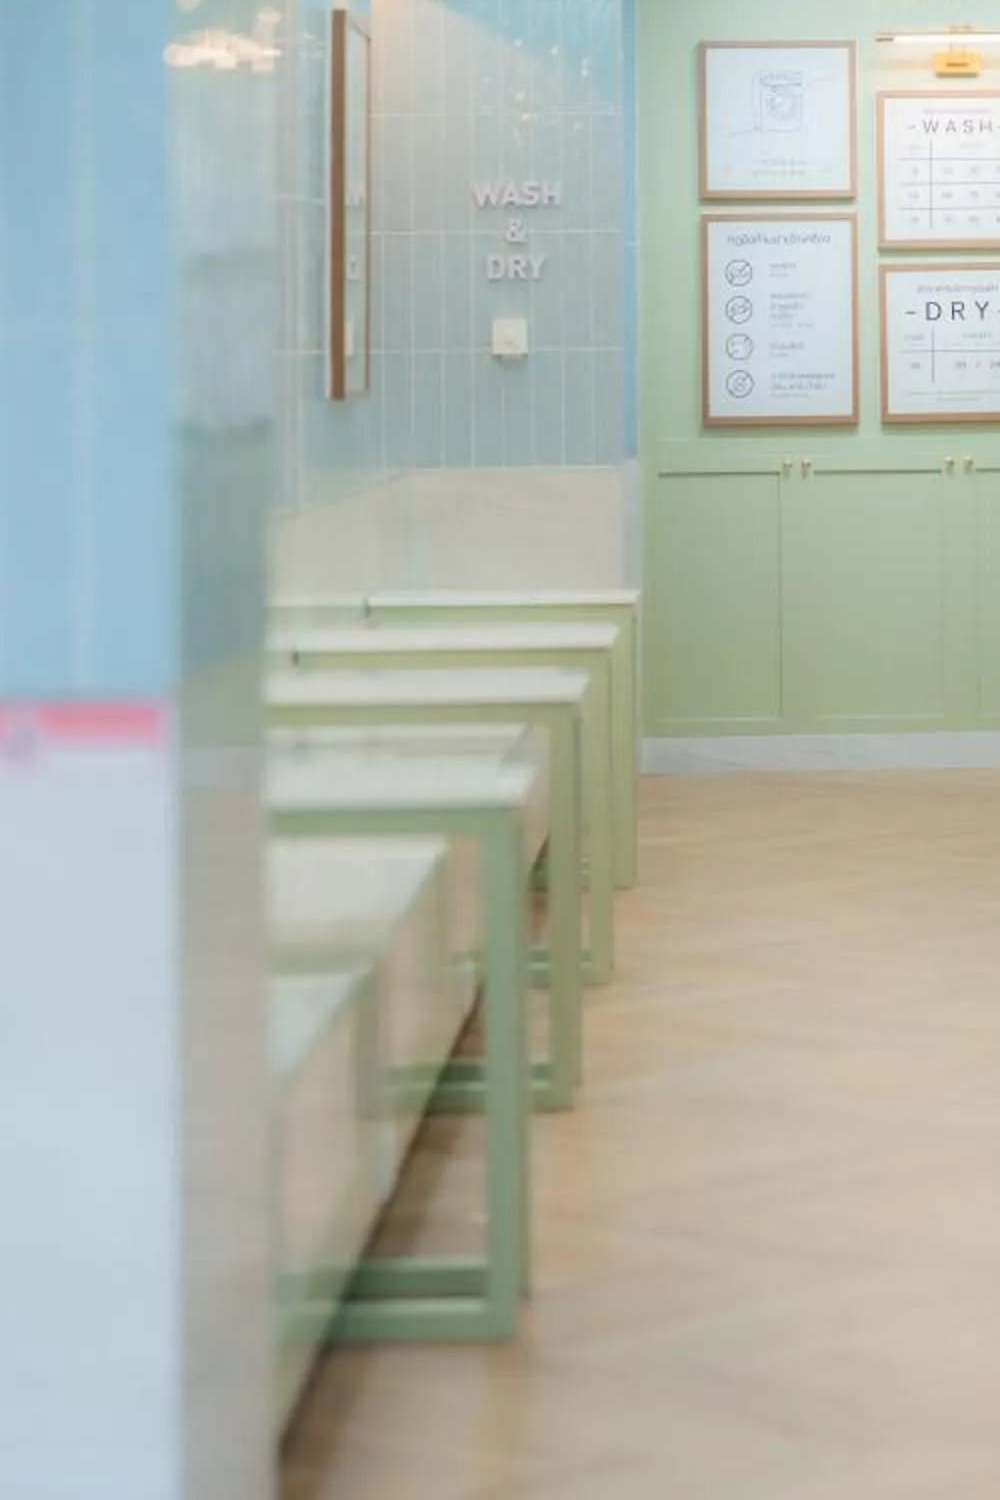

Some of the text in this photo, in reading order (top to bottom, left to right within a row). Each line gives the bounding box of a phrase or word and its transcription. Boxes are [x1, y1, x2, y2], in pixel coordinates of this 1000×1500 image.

[472, 180, 562, 208] WASH
[505, 217, 528, 243] &
[485, 253, 546, 281] DRY
